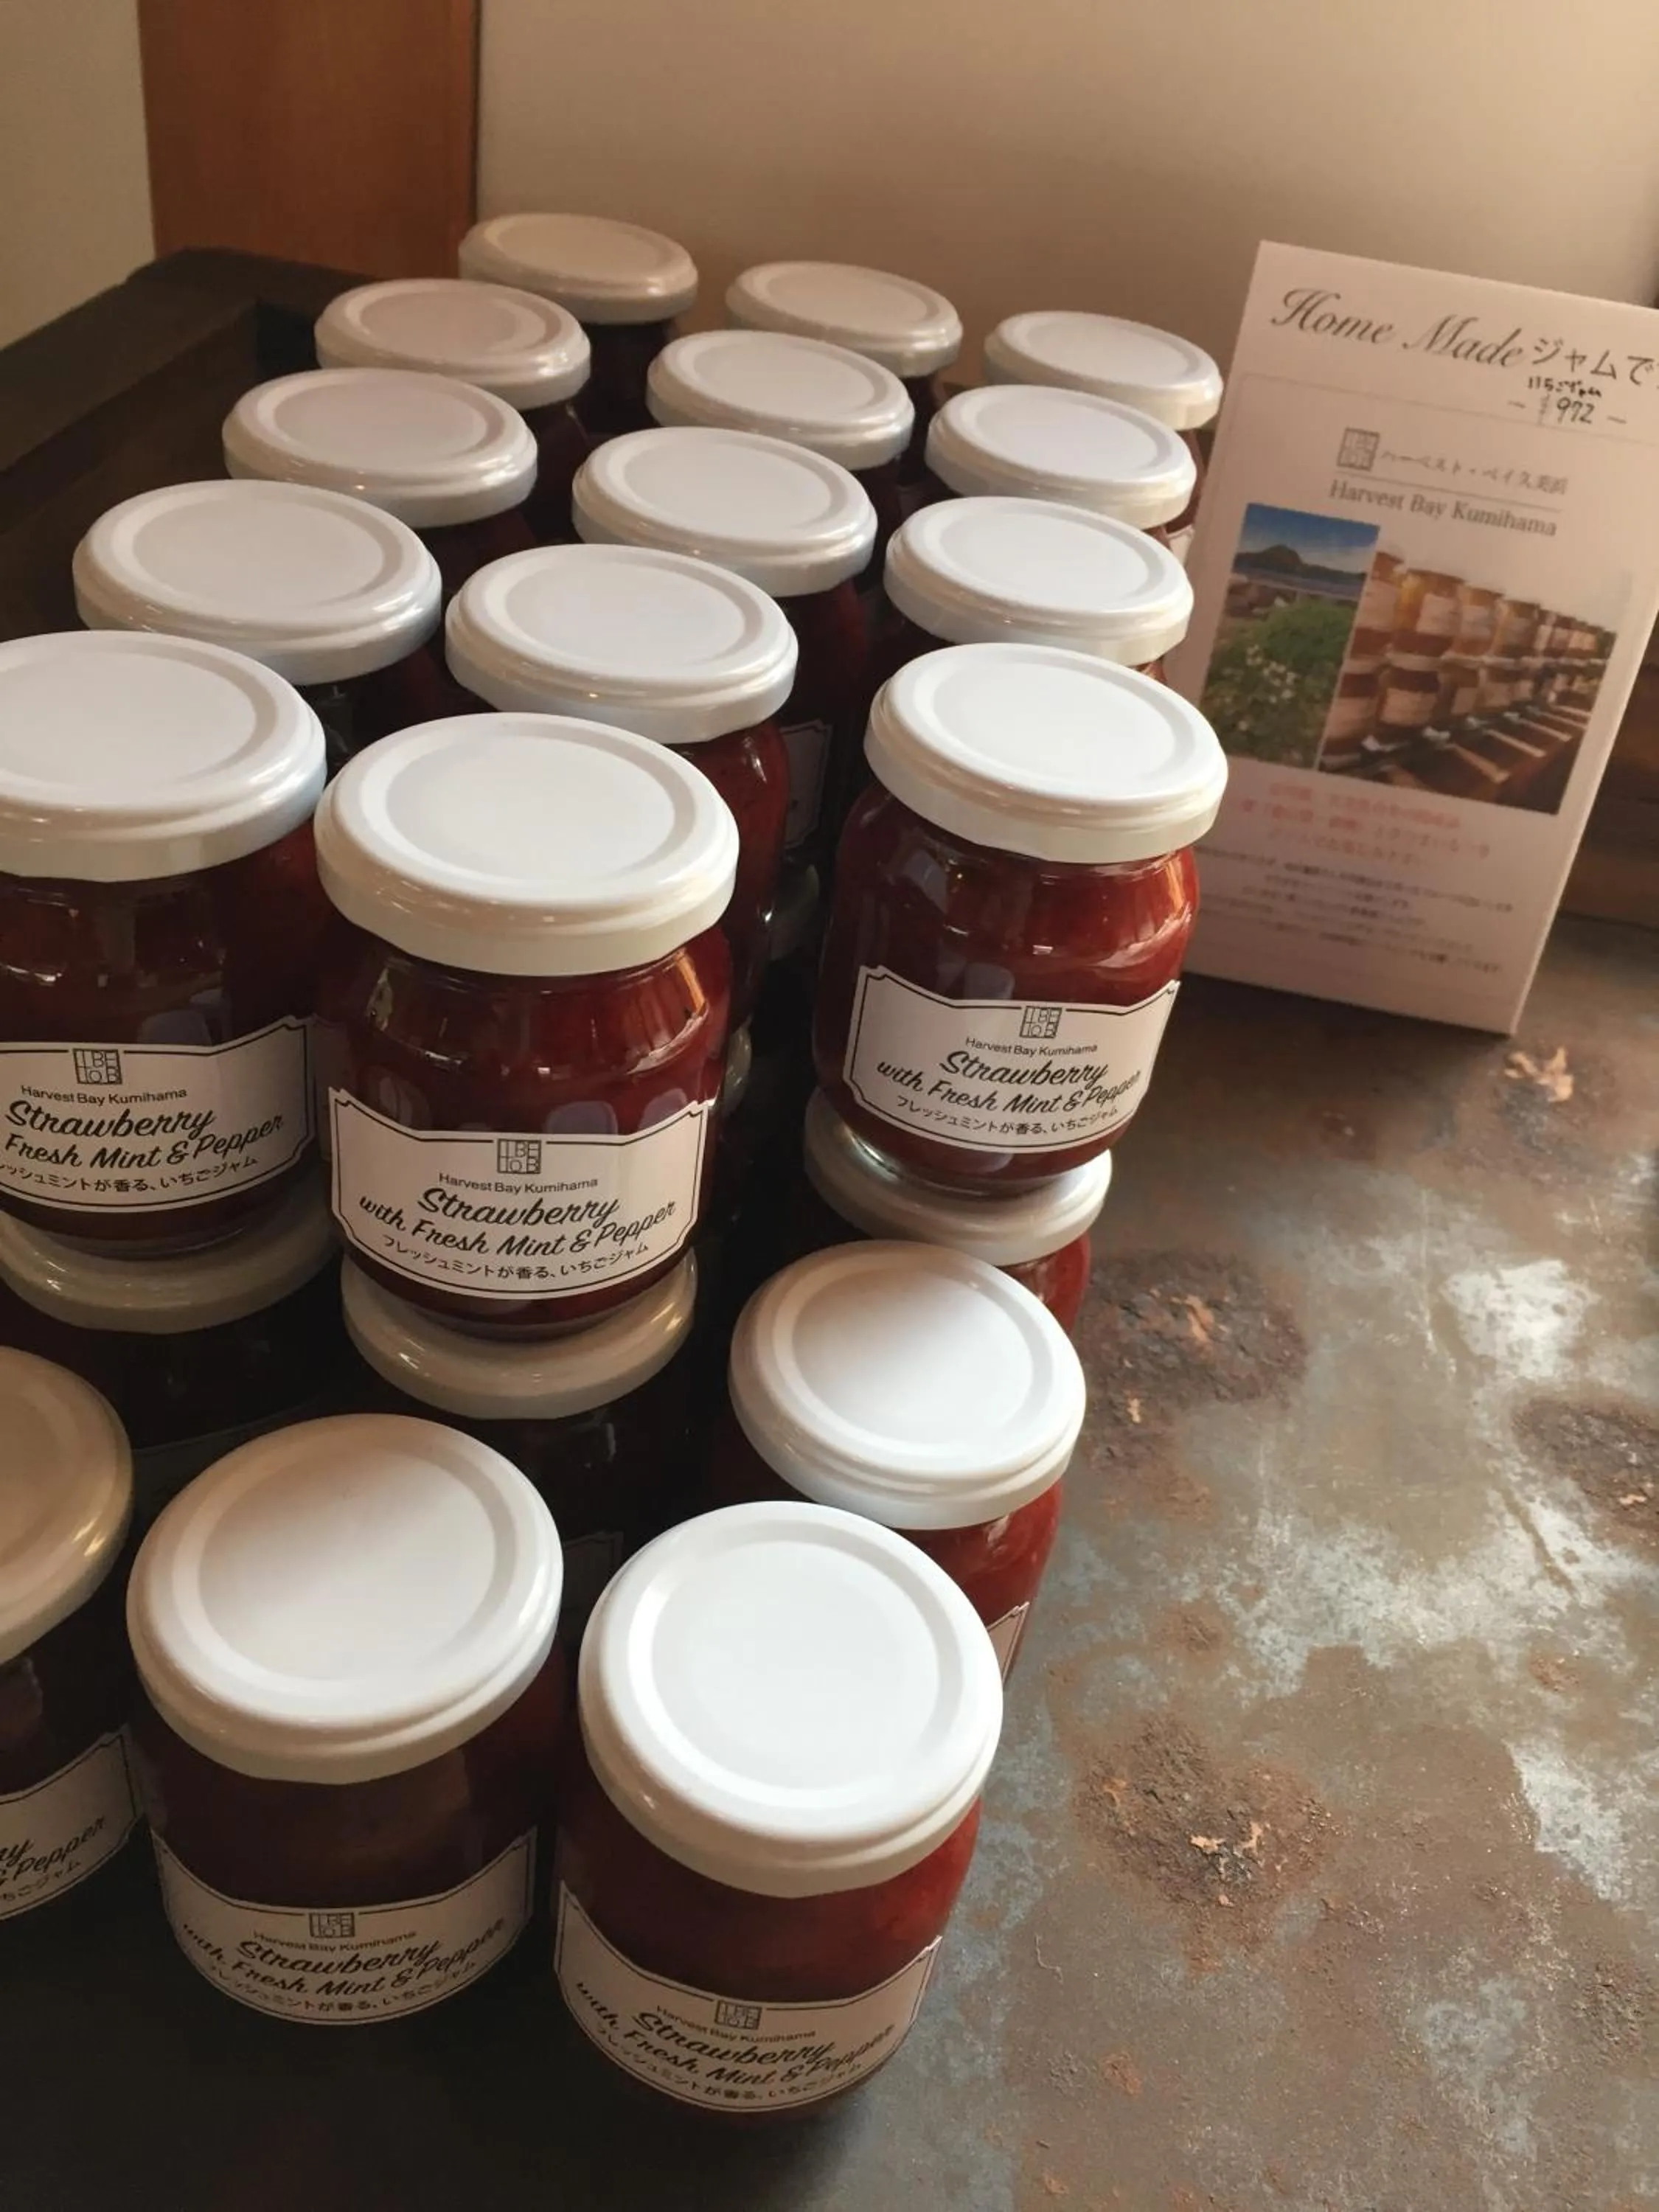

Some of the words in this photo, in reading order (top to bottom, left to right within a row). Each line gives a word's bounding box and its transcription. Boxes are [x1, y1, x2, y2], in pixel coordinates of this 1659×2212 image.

[1270, 288, 1394, 344] Home
[1402, 314, 1524, 368] Made
[1532, 338, 1659, 389] ジャムで
[1329, 479, 1405, 512] Harvest
[1410, 494, 1447, 520] Bay
[1451, 501, 1557, 536] Kumihama
[965, 1037, 1012, 1054] Harvest
[1013, 1045, 1037, 1057] Bay
[1039, 1043, 1098, 1057] Kumihama
[877, 1060, 924, 1093] with
[928, 1082, 998, 1111] Fresh
[1003, 1094, 1068, 1115] Mint
[939, 1051, 1109, 1091] Strawberry
[21, 1085, 74, 1103] Harvest
[76, 1093, 105, 1106] Bay
[108, 1087, 187, 1104] Kumihama
[4, 1099, 216, 1140] Strawberry
[5, 1133, 82, 1168] Fresh
[89, 1146, 163, 1169] Mint
[439, 1172, 493, 1192] Harvest
[494, 1181, 522, 1194] Bay
[524, 1178, 598, 1194] Kumihama
[359, 1194, 406, 1231] with
[412, 1222, 492, 1253] Fresh
[496, 1235, 575, 1256] Mint
[417, 1188, 620, 1230] Strawberry
[183, 1923, 226, 1962] with
[232, 1961, 307, 1993] Fresh
[316, 1978, 385, 1996] Mint
[236, 1939, 441, 1973] Strawberry
[576, 1981, 621, 2030] with
[623, 2031, 699, 2073] Fresh
[706, 2067, 776, 2086] Mint
[630, 2011, 838, 2065] Strawberry
